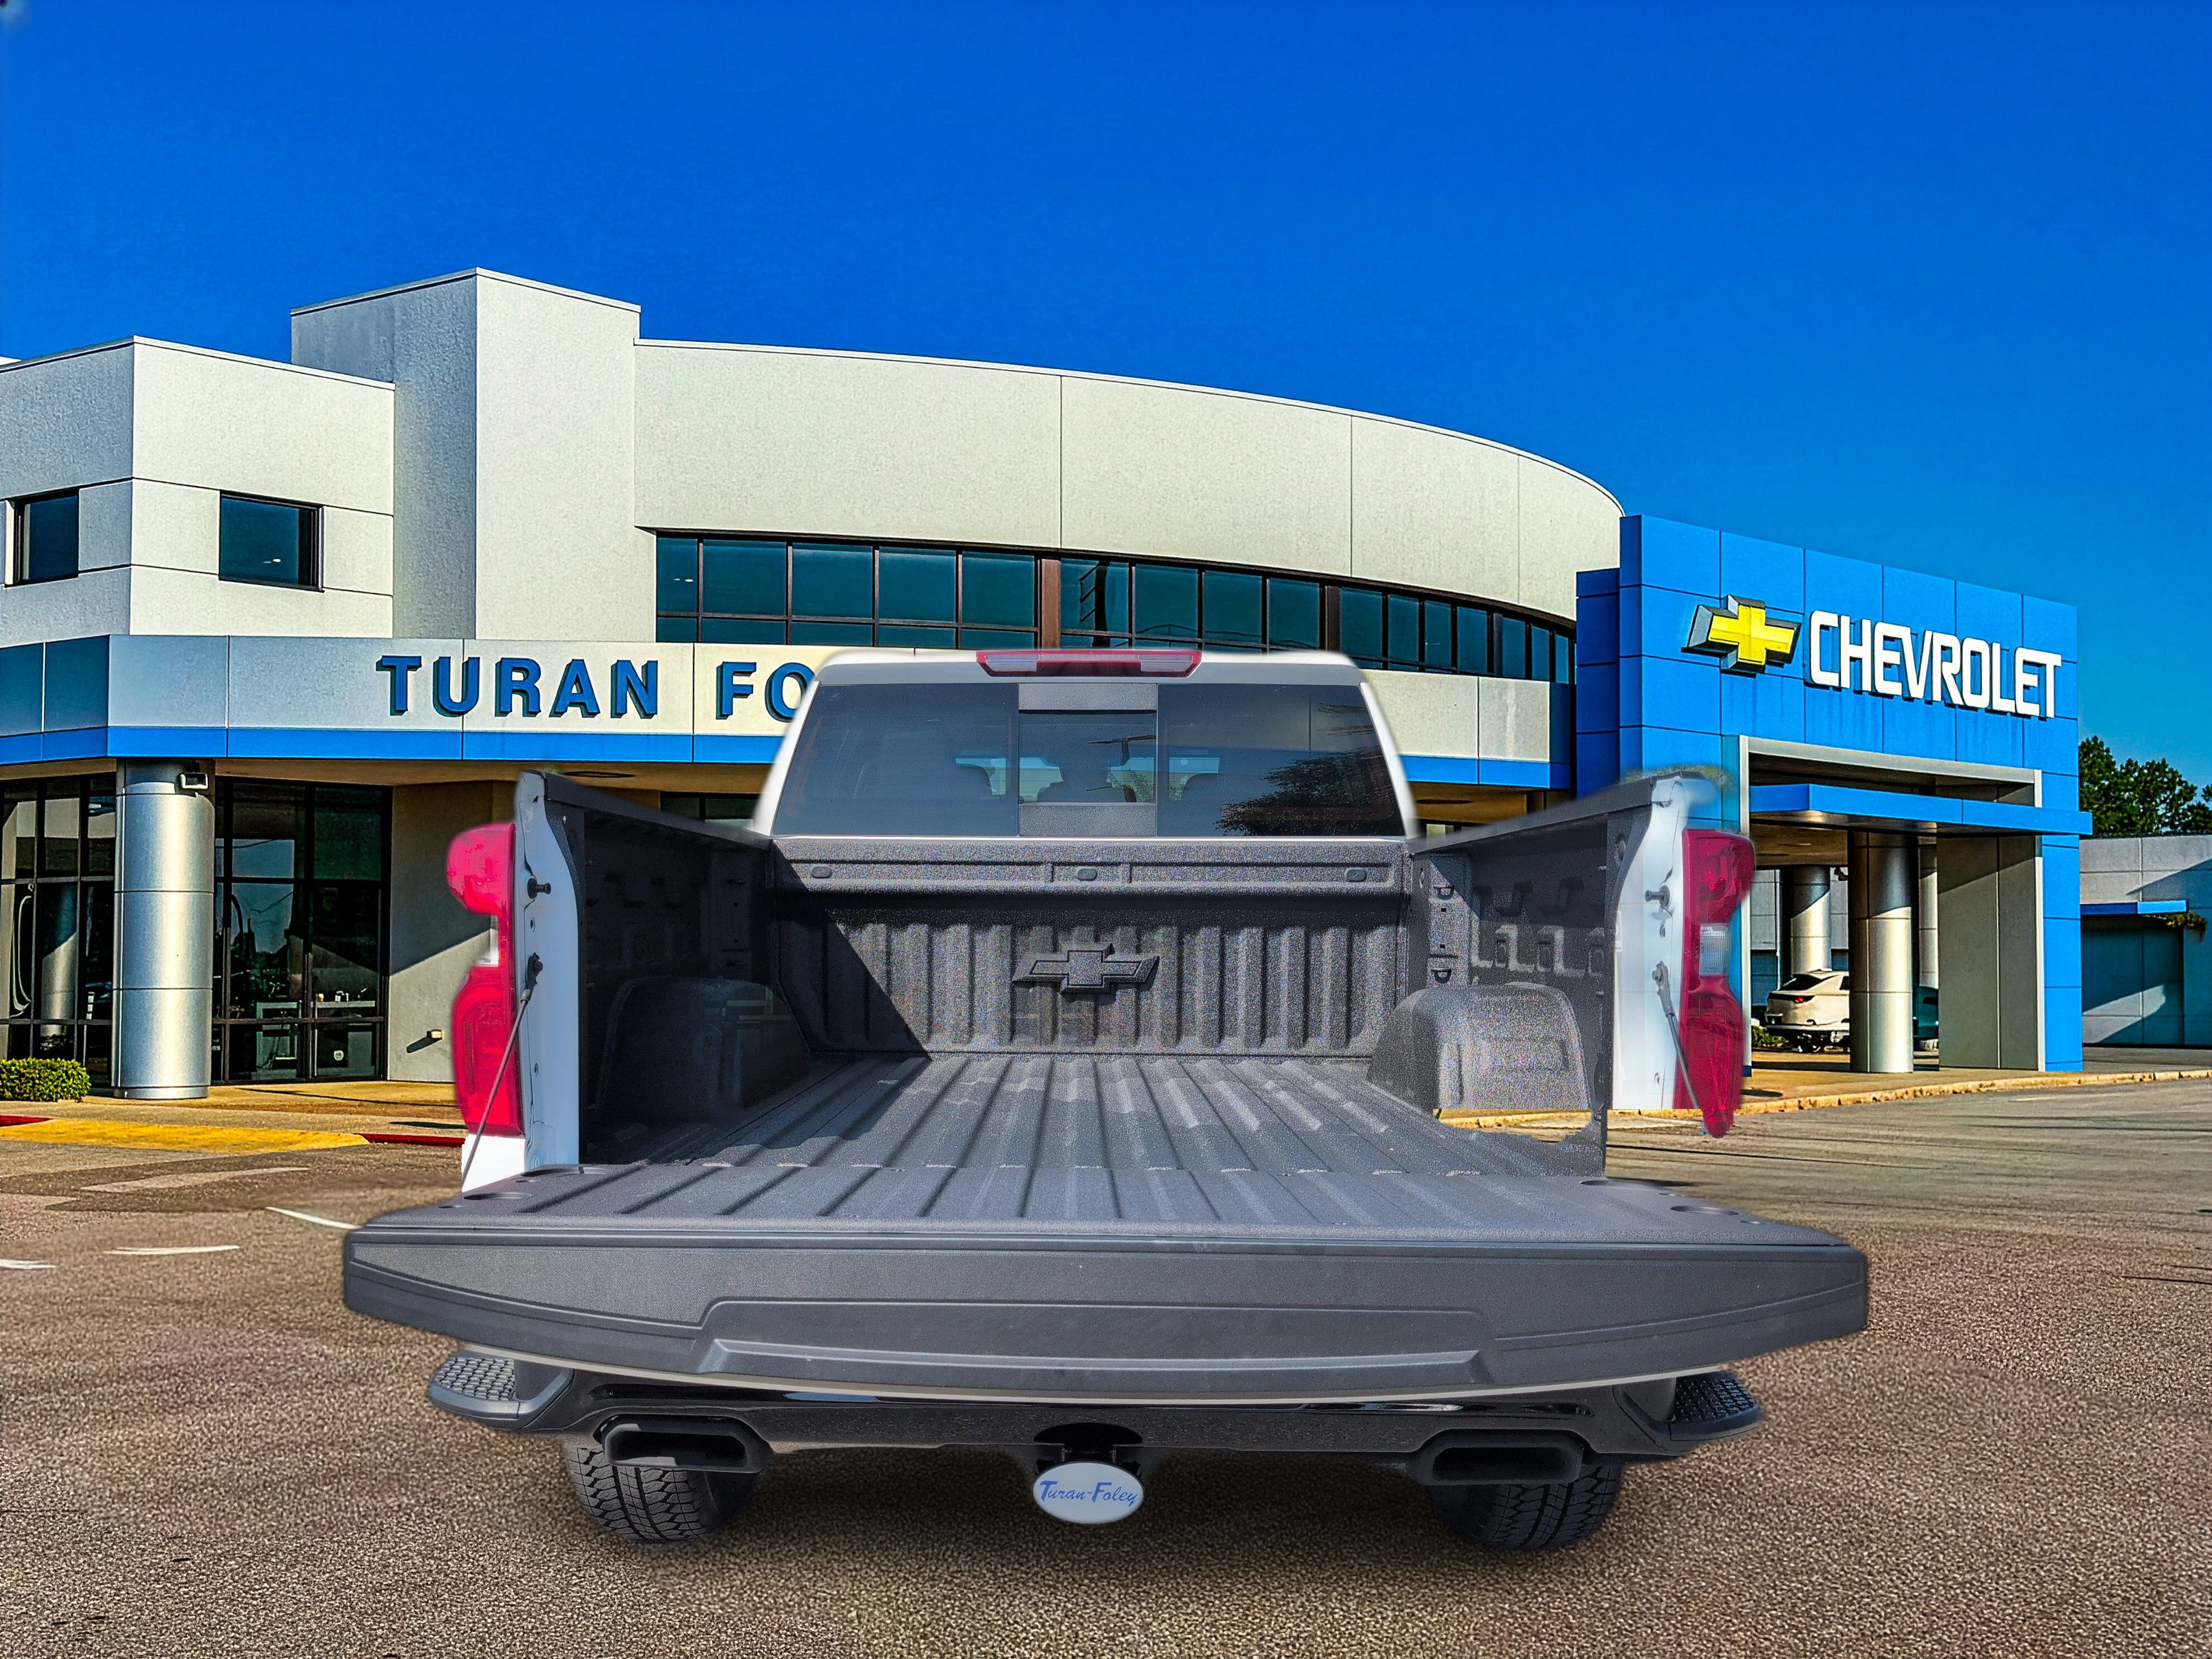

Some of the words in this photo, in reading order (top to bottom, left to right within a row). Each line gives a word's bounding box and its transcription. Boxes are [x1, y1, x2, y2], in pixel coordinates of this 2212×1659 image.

[376, 654, 659, 719] TURAN
[1810, 610, 2062, 718] CHEVROLET
[1039, 1480, 1138, 1507] Turan-Foley
